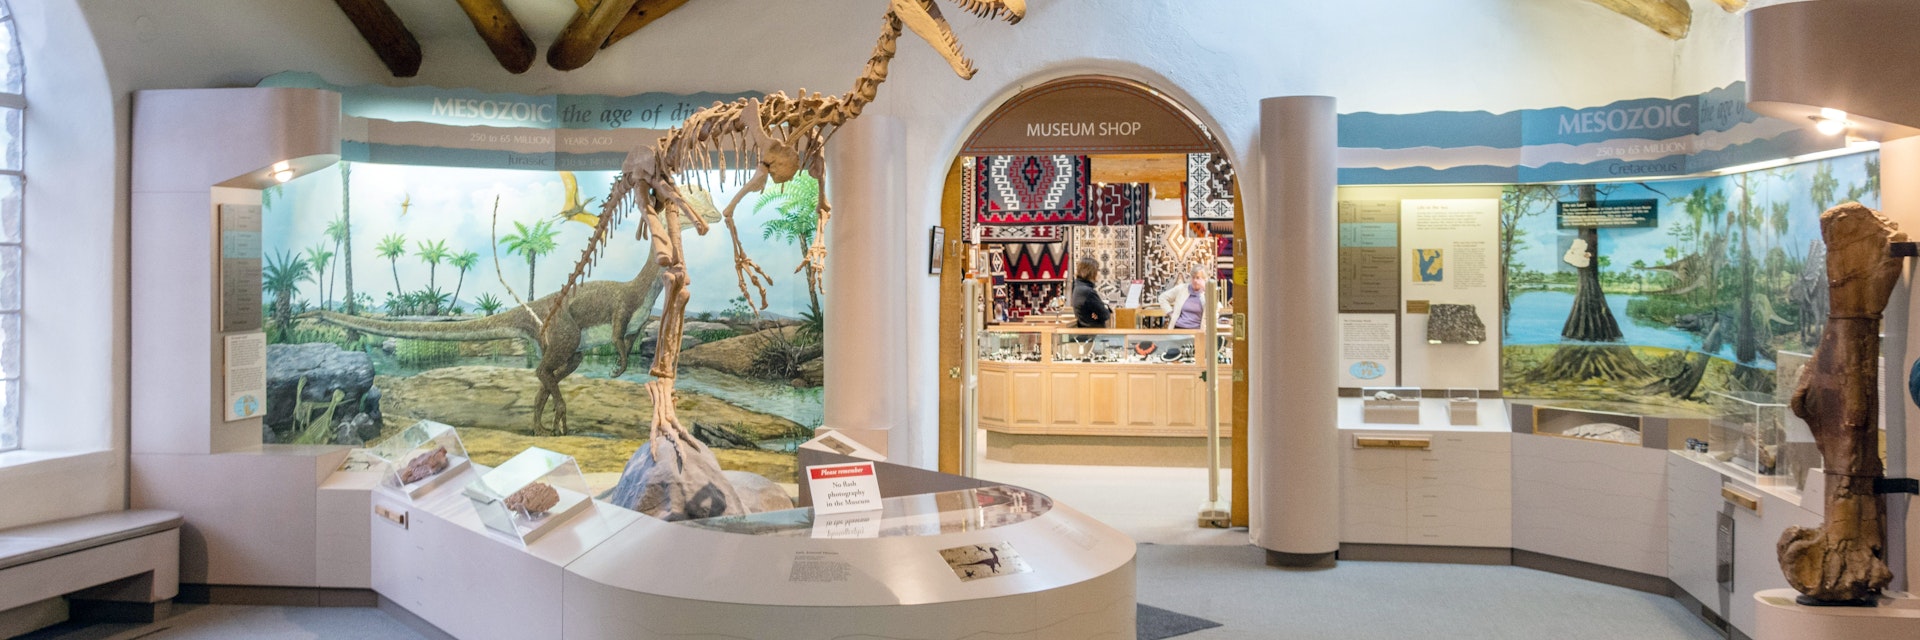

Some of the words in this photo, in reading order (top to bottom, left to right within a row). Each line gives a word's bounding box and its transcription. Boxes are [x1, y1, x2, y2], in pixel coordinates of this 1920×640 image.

[431, 97, 553, 123] MESOZOIC
[562, 104, 592, 123] the
[600, 109, 633, 129] age
[641, 103, 664, 129] of
[1558, 103, 1692, 135] MESOZOIC
[1026, 122, 1095, 137] MUSEUM
[1099, 121, 1141, 136] SHOP
[470, 132, 487, 142] 250
[489, 134, 497, 143] to
[500, 134, 511, 143] 65
[514, 135, 551, 145] MILLION
[563, 136, 589, 146] YEARS
[592, 136, 613, 146] AGO
[1596, 146, 1613, 157] 250
[1615, 146, 1625, 156] to
[1628, 144, 1640, 155] 65
[1643, 141, 1686, 154] MILLION
[508, 153, 549, 167] Jurassic
[1608, 162, 1678, 176] Cretaceous
[821, 468, 837, 476] Please
[838, 466, 863, 475] remember
[827, 489, 865, 499] photography
